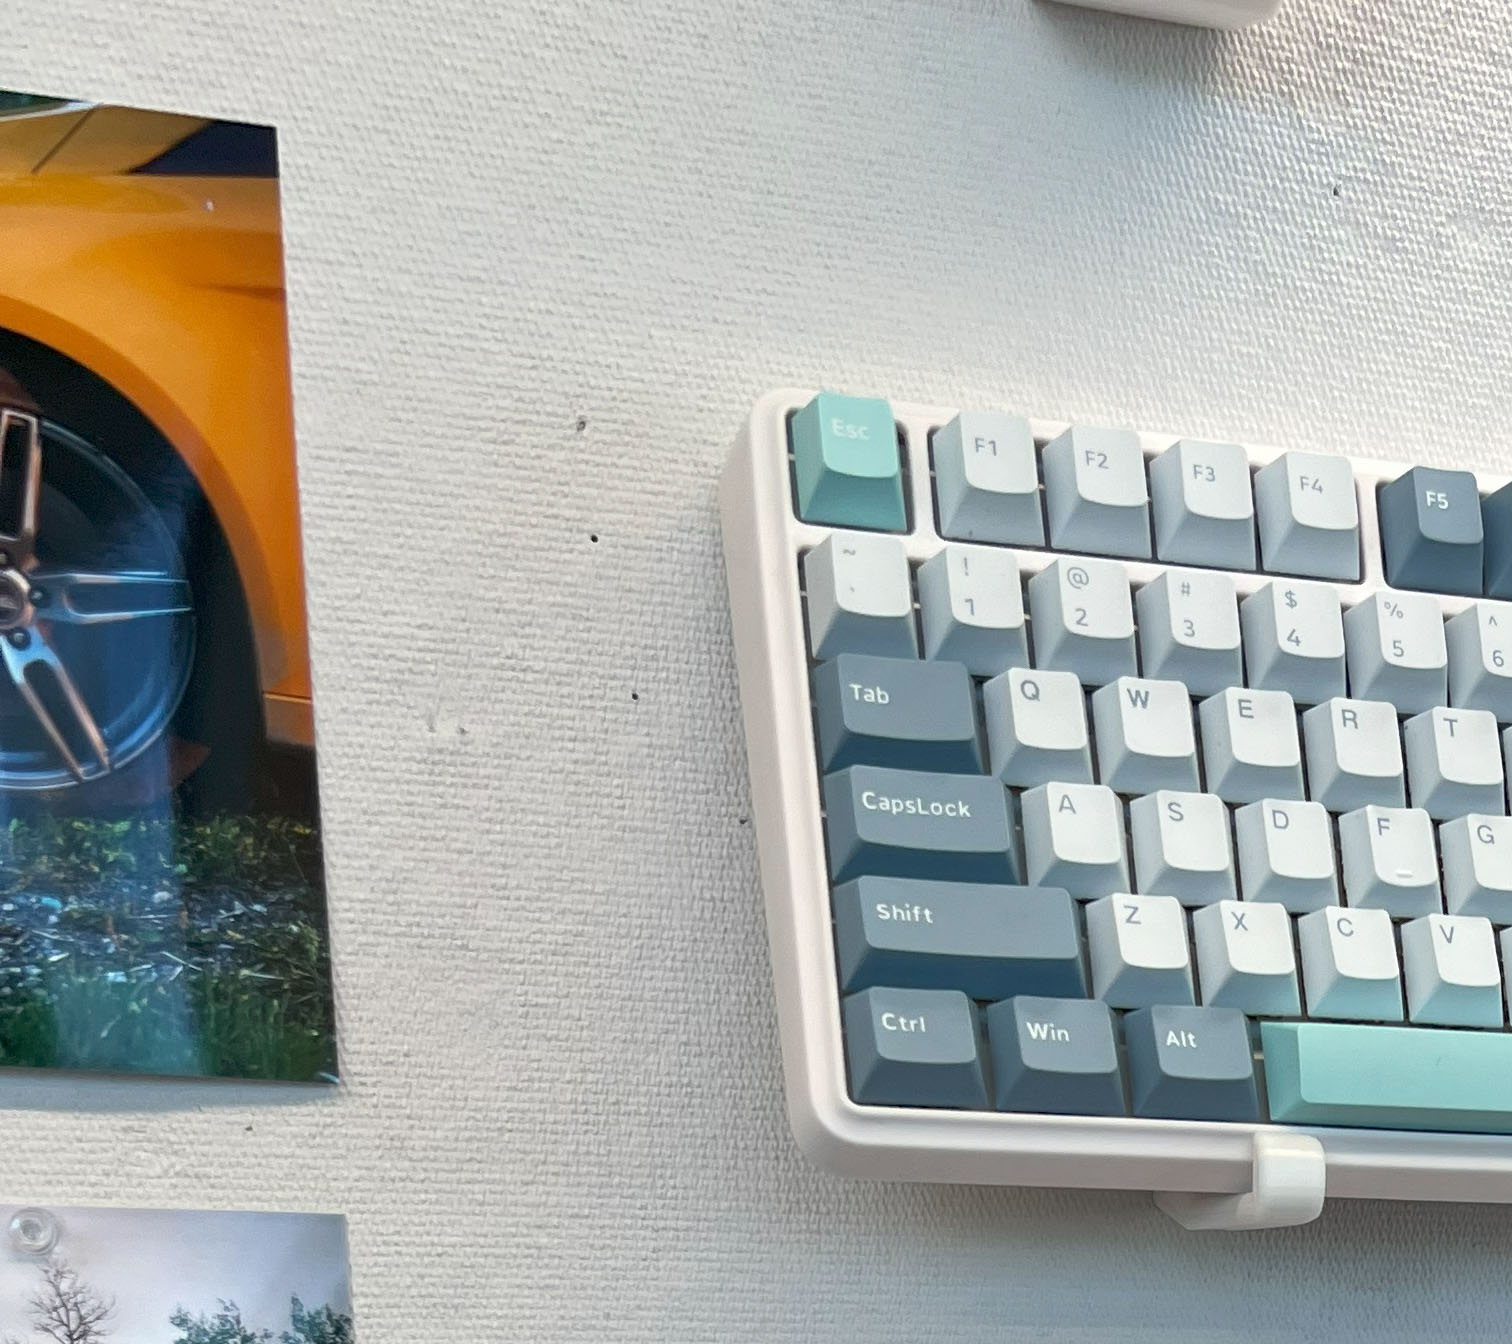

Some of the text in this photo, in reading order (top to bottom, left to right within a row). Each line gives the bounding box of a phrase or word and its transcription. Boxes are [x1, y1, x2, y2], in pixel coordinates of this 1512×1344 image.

[831, 418, 869, 440] Esc
[975, 437, 997, 456] F1
[1085, 450, 1109, 469] F2
[1193, 464, 1216, 482] F3
[1300, 476, 1323, 494] F4
[1426, 491, 1448, 509] F5
[962, 557, 970, 576] !
[1067, 566, 1089, 590] @
[1181, 582, 1191, 597] #
[964, 598, 975, 616] 1
[1285, 590, 1297, 609] $
[1075, 608, 1088, 627] 2
[1384, 601, 1404, 619] %
[1184, 619, 1195, 637] 3
[1287, 628, 1301, 647] 4
[1393, 640, 1404, 657] 5
[1493, 650, 1504, 667] 6
[849, 683, 889, 704] Tab
[1020, 680, 1040, 701] Q
[1126, 688, 1149, 709] W
[1238, 699, 1254, 719] E
[1341, 709, 1358, 729] R
[1443, 717, 1458, 737] T
[862, 791, 971, 817] CapsLock
[1058, 794, 1076, 814] A
[1168, 802, 1184, 822] S
[1272, 809, 1289, 830] D
[1377, 817, 1390, 836] F
[1477, 824, 1495, 844] G
[876, 903, 933, 923] Shift
[1124, 905, 1141, 925] Z
[1231, 912, 1248, 931] X
[1337, 918, 1354, 937] C
[1439, 925, 1454, 944] V
[882, 1012, 925, 1032] Ctrl
[1026, 1022, 1069, 1041] Win
[1166, 1030, 1197, 1048] Alt
